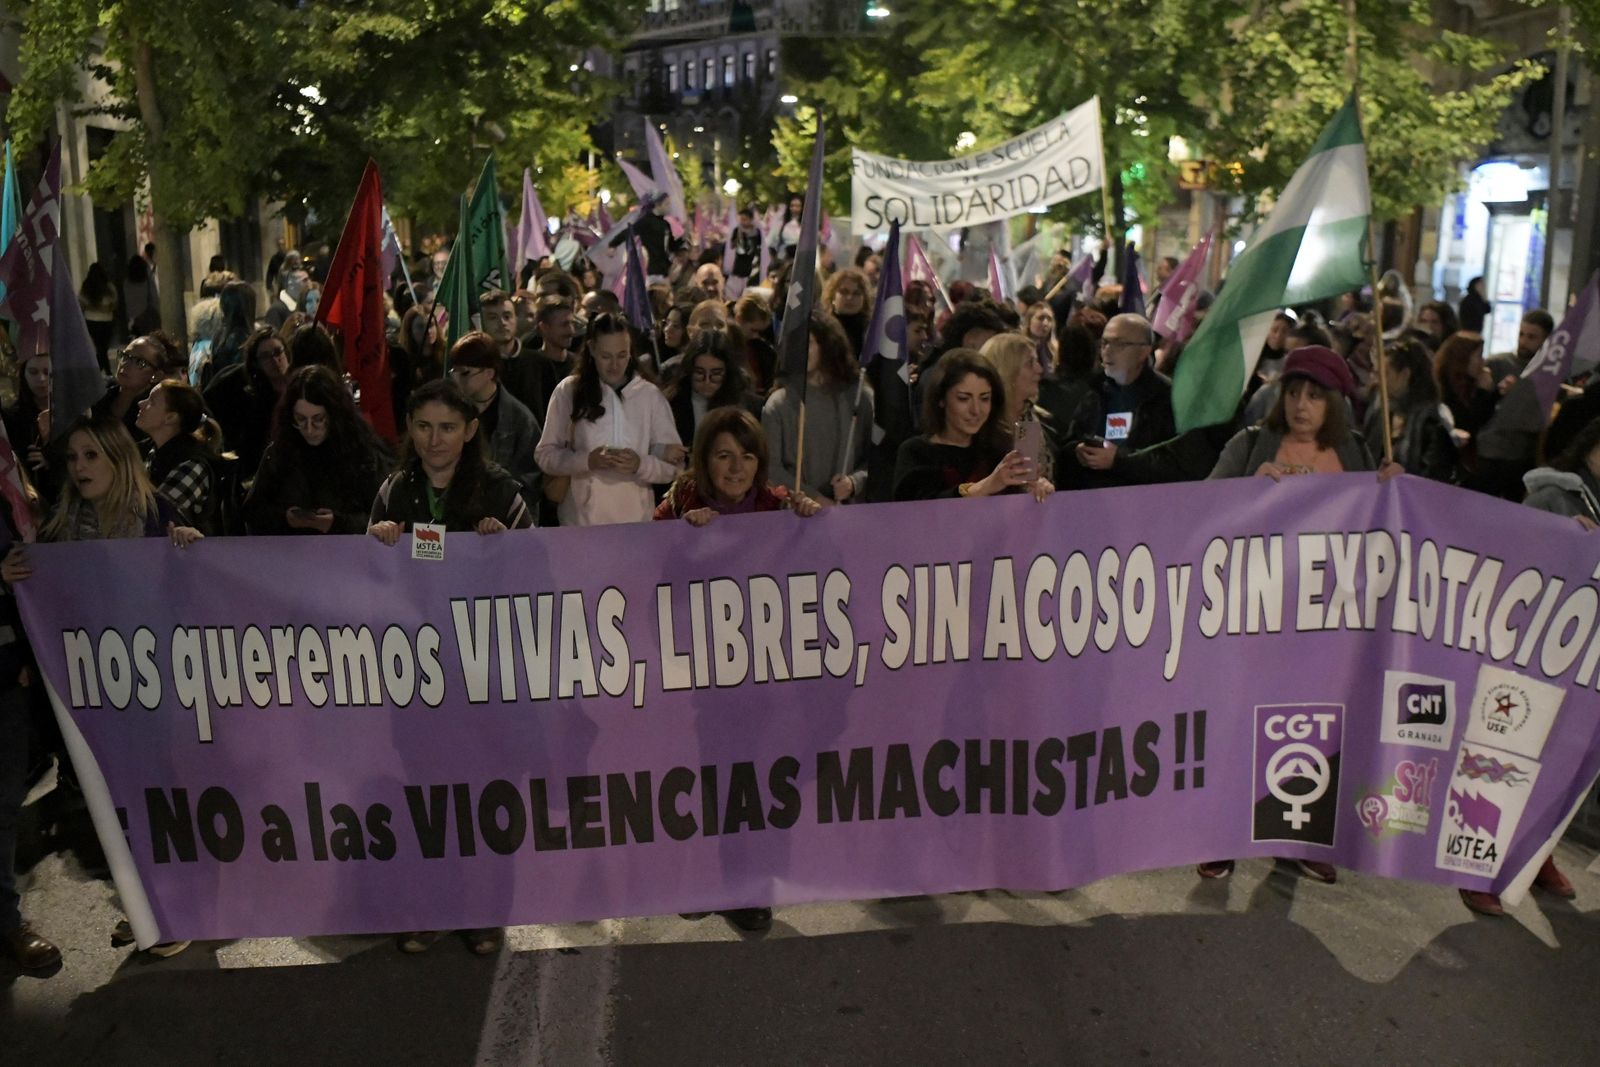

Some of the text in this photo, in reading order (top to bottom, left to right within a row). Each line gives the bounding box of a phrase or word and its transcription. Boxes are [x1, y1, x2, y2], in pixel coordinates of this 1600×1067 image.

[975, 121, 1071, 168] ESCUELA
[865, 156, 1091, 230] SOLIDARIDAD
[1541, 329, 1571, 377] CGT
[416, 542, 443, 551] USTEA
[62, 624, 163, 710] nos
[171, 622, 446, 743] queremos
[450, 585, 648, 708] VIVAS,
[656, 568, 870, 688] LIBRES,
[880, 560, 973, 670] SIN
[982, 542, 1157, 662] ACOSO
[1163, 563, 1192, 681] y
[1198, 533, 1284, 638] SIN
[1406, 694, 1442, 715] CNT
[1264, 713, 1336, 741] CGT
[1398, 729, 1442, 744] GRANADA
[1486, 720, 1508, 735] USE
[144, 786, 245, 864] NO
[260, 803, 298, 862] a
[304, 782, 397, 862] las
[403, 755, 802, 859] VIOLENCIAS
[1446, 833, 1498, 862] USTEA
